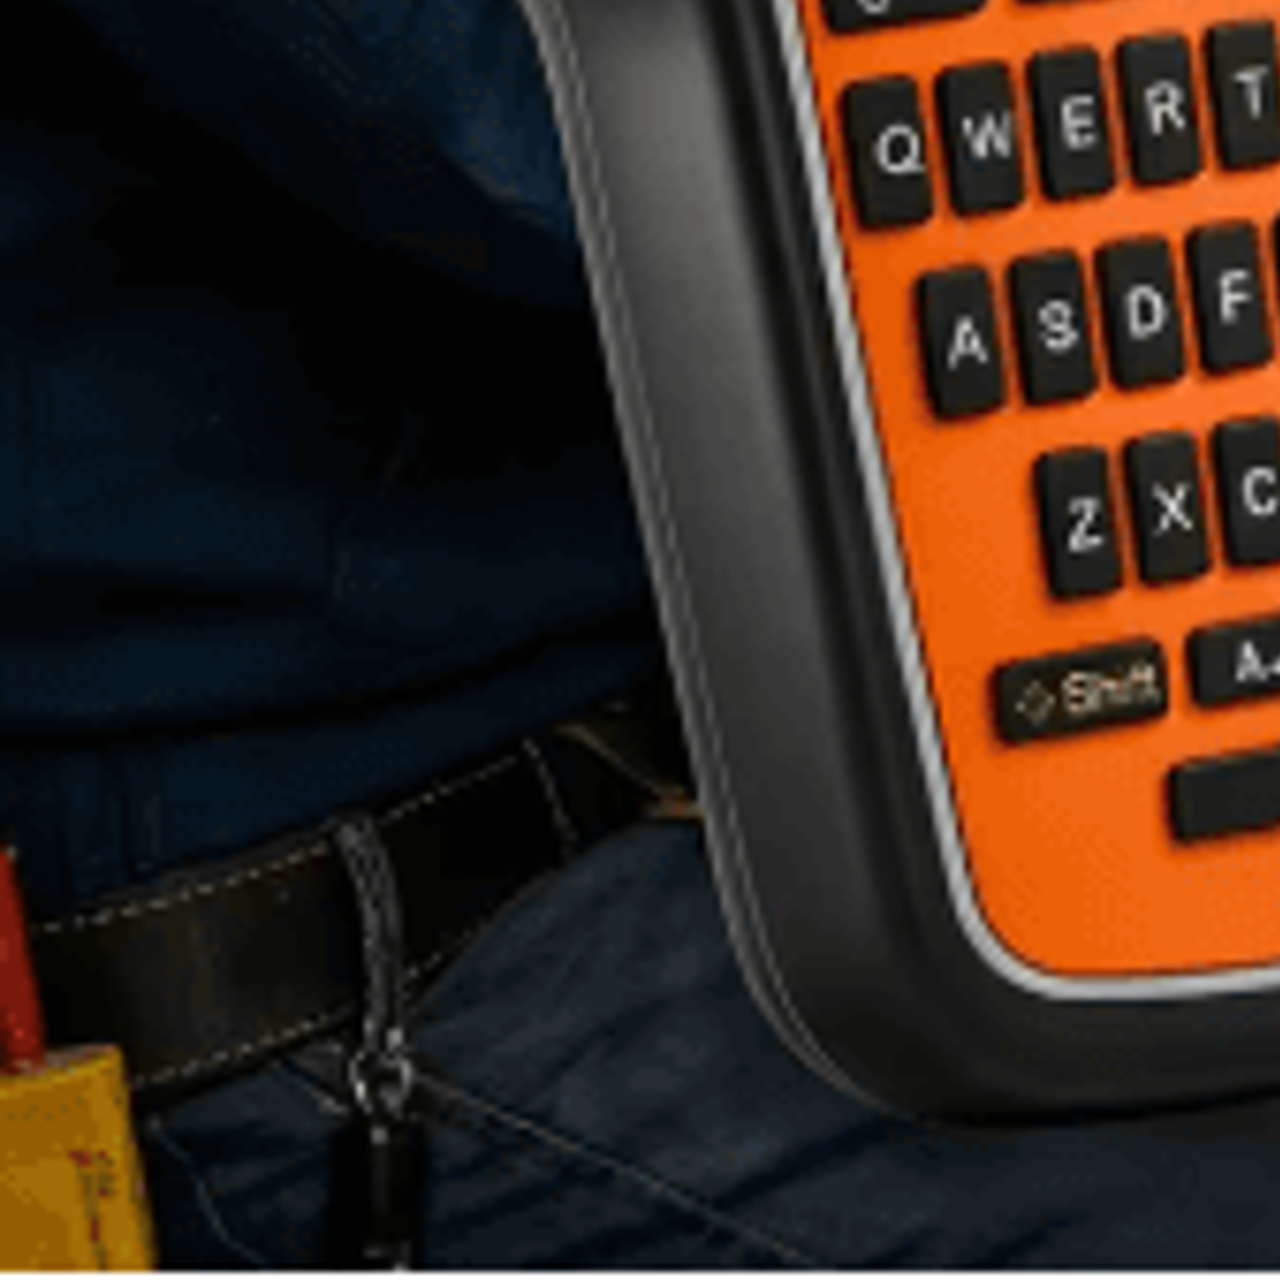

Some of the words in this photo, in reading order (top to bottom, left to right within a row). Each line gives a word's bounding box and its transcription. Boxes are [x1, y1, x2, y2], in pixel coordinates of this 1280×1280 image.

[874, 122, 926, 176] Q
[960, 113, 1012, 160] W
[1059, 93, 1097, 151] E
[1143, 79, 1187, 136] R
[1233, 65, 1268, 119] T
[947, 315, 990, 368] A
[1037, 298, 1080, 352] S
[1125, 283, 1167, 340] D
[1217, 267, 1250, 322] F
[1067, 495, 1105, 554] Z
[1153, 483, 1194, 532] X
[1240, 465, 1280, 518] C
